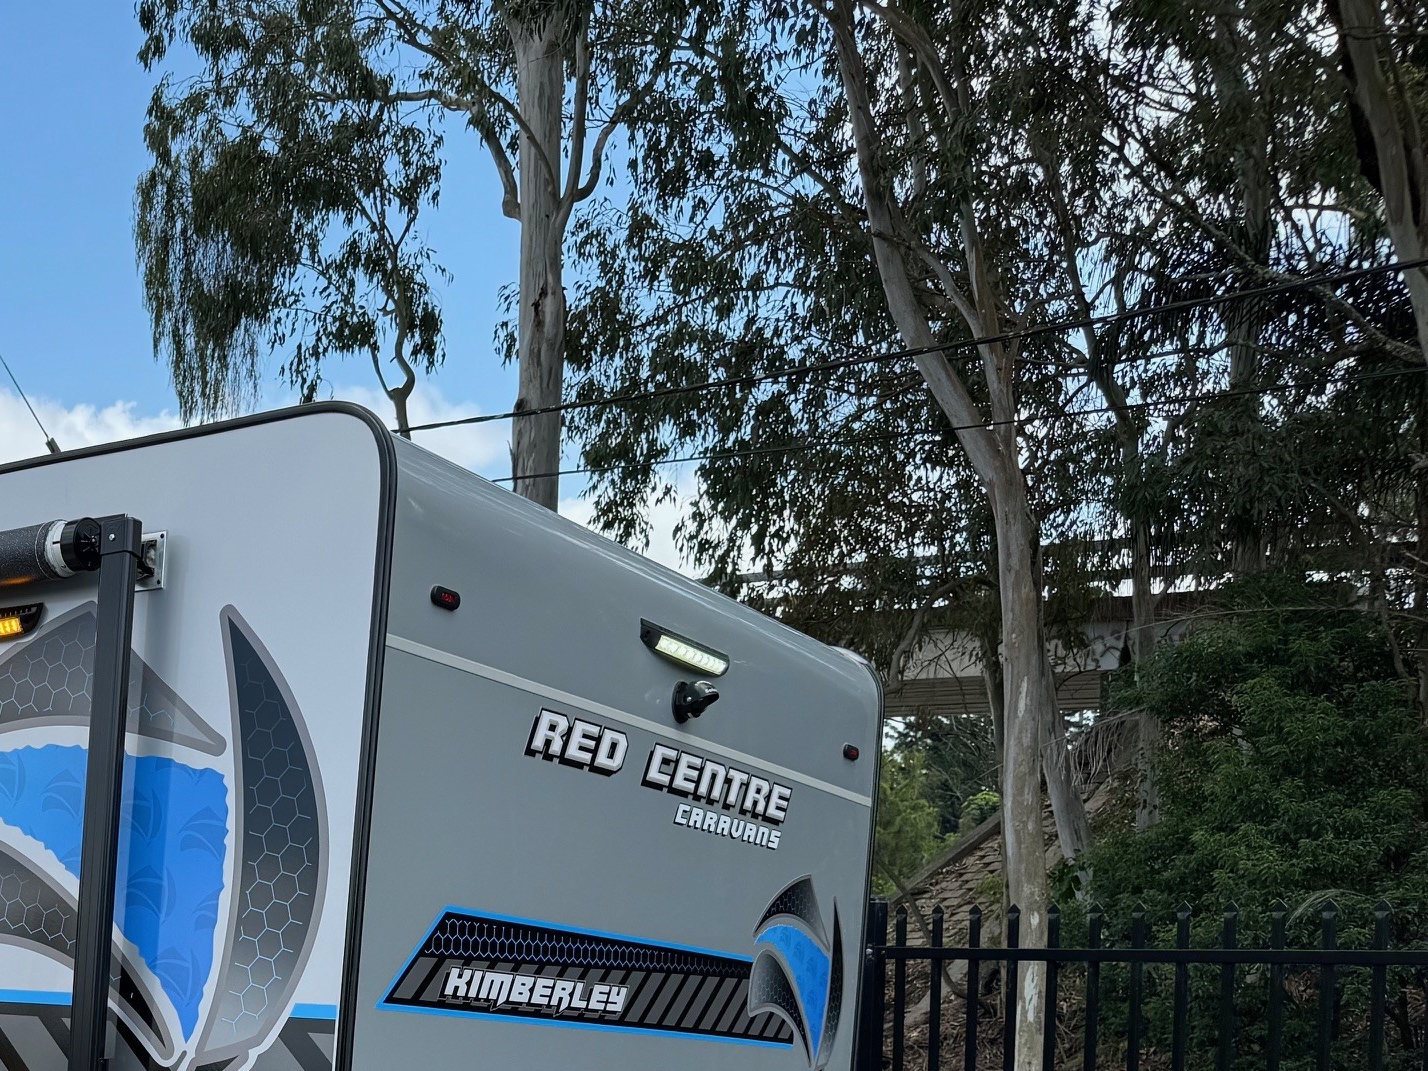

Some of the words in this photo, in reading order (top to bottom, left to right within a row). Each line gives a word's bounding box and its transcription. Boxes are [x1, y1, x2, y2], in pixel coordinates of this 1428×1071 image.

[526, 708, 628, 776] RED
[643, 743, 792, 825] CENTRE
[674, 803, 781, 849] CARAVANS
[443, 966, 629, 1014] KIMBERLEY
